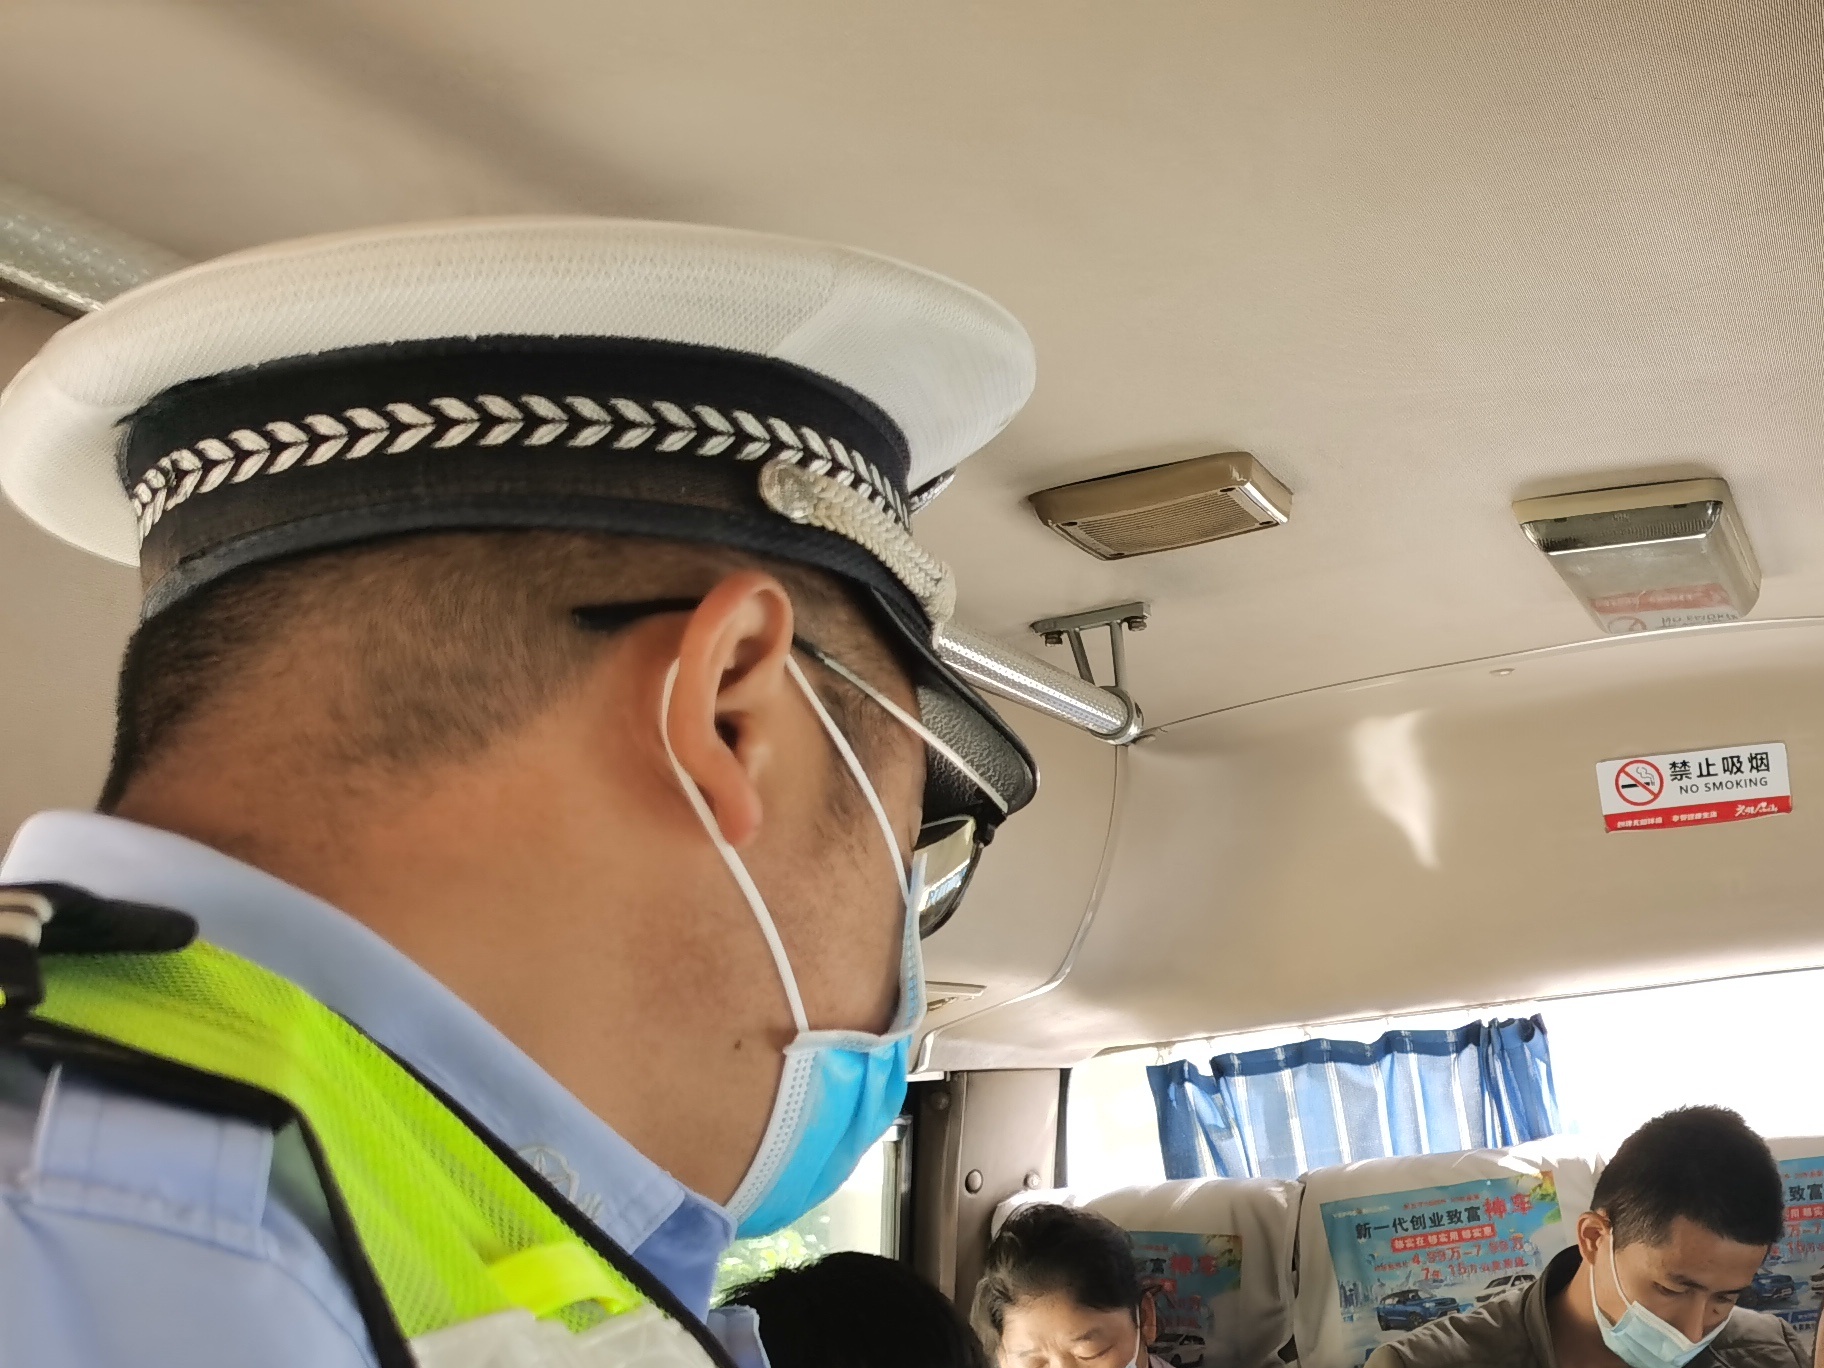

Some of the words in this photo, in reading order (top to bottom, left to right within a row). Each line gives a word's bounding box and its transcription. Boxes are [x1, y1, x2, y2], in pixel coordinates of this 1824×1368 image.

[1668, 751, 1771, 782] 禁止吸烟
[1679, 783, 1700, 795] NO
[1704, 776, 1769, 793] SMOKING
